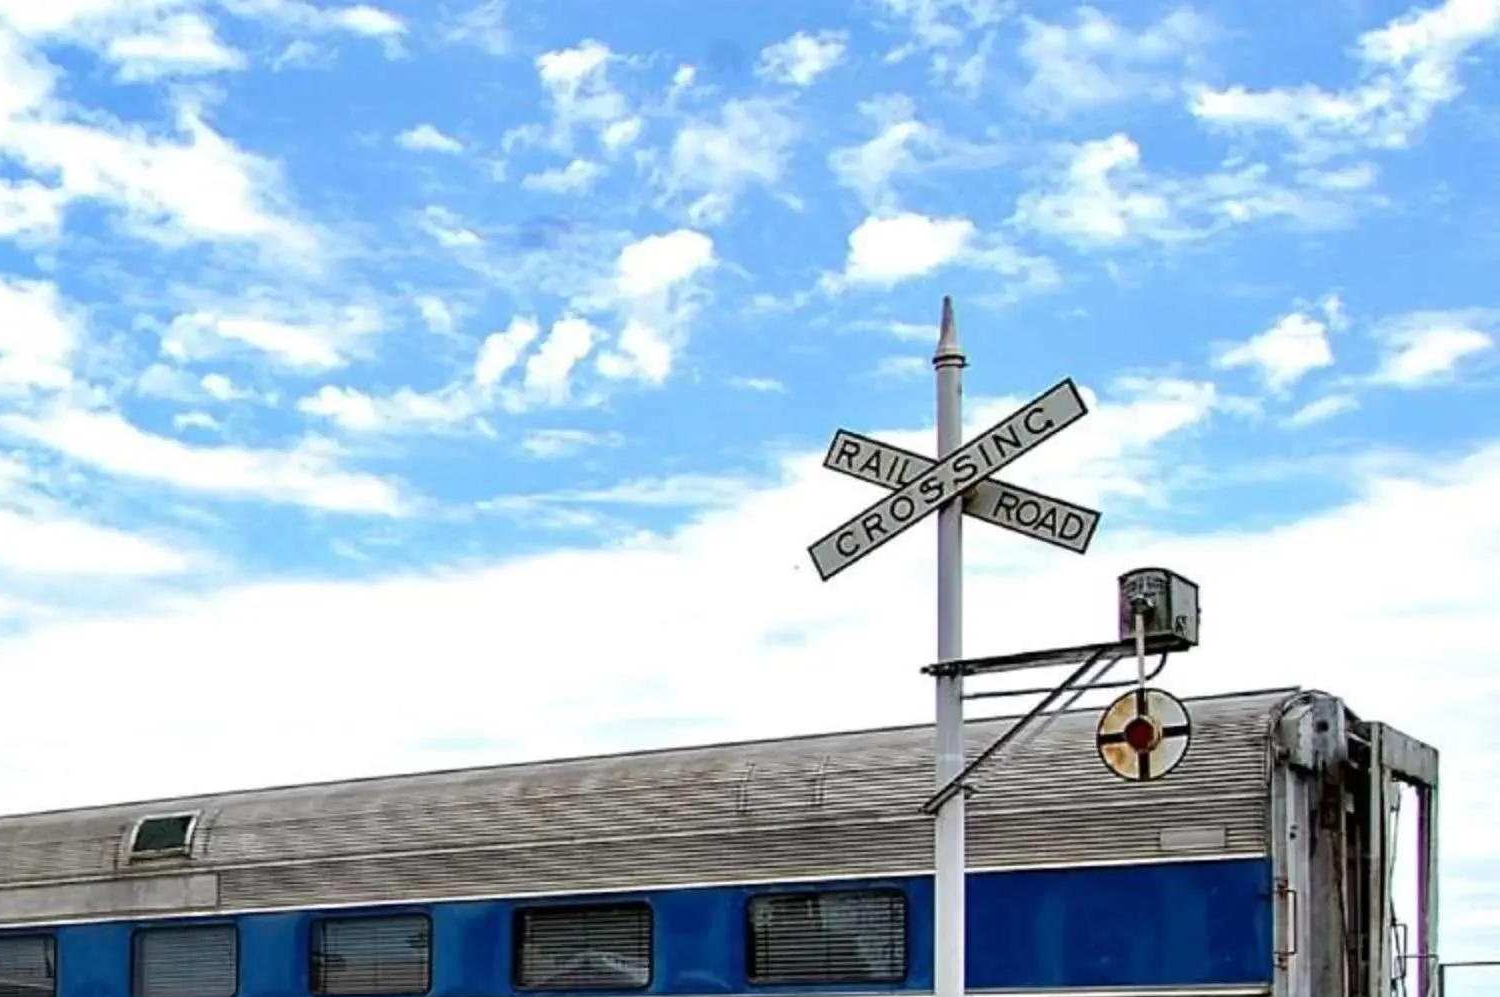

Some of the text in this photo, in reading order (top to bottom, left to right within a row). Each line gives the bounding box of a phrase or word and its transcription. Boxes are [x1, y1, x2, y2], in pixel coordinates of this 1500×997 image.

[835, 406, 1054, 558] CROSSING
[835, 440, 1084, 540] RAIL ROAD
